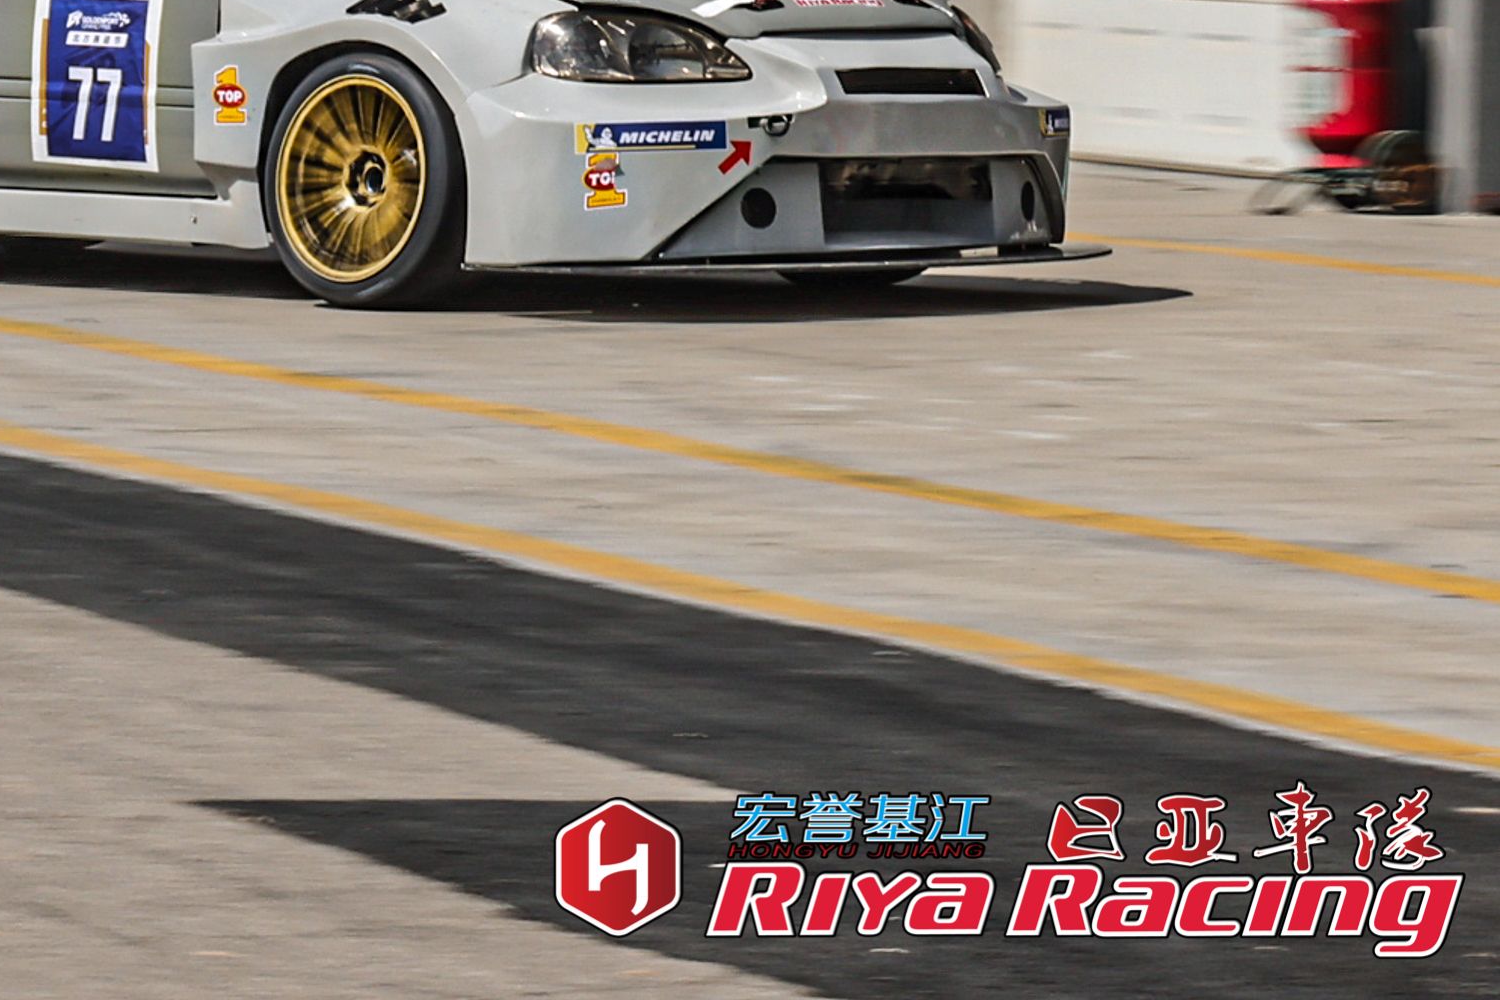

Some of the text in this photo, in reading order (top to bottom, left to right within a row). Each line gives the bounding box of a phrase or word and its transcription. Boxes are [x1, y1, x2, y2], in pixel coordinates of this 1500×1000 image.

[217, 90, 242, 102] TOP
[68, 66, 122, 141] 77
[619, 130, 715, 144] MICHELIN
